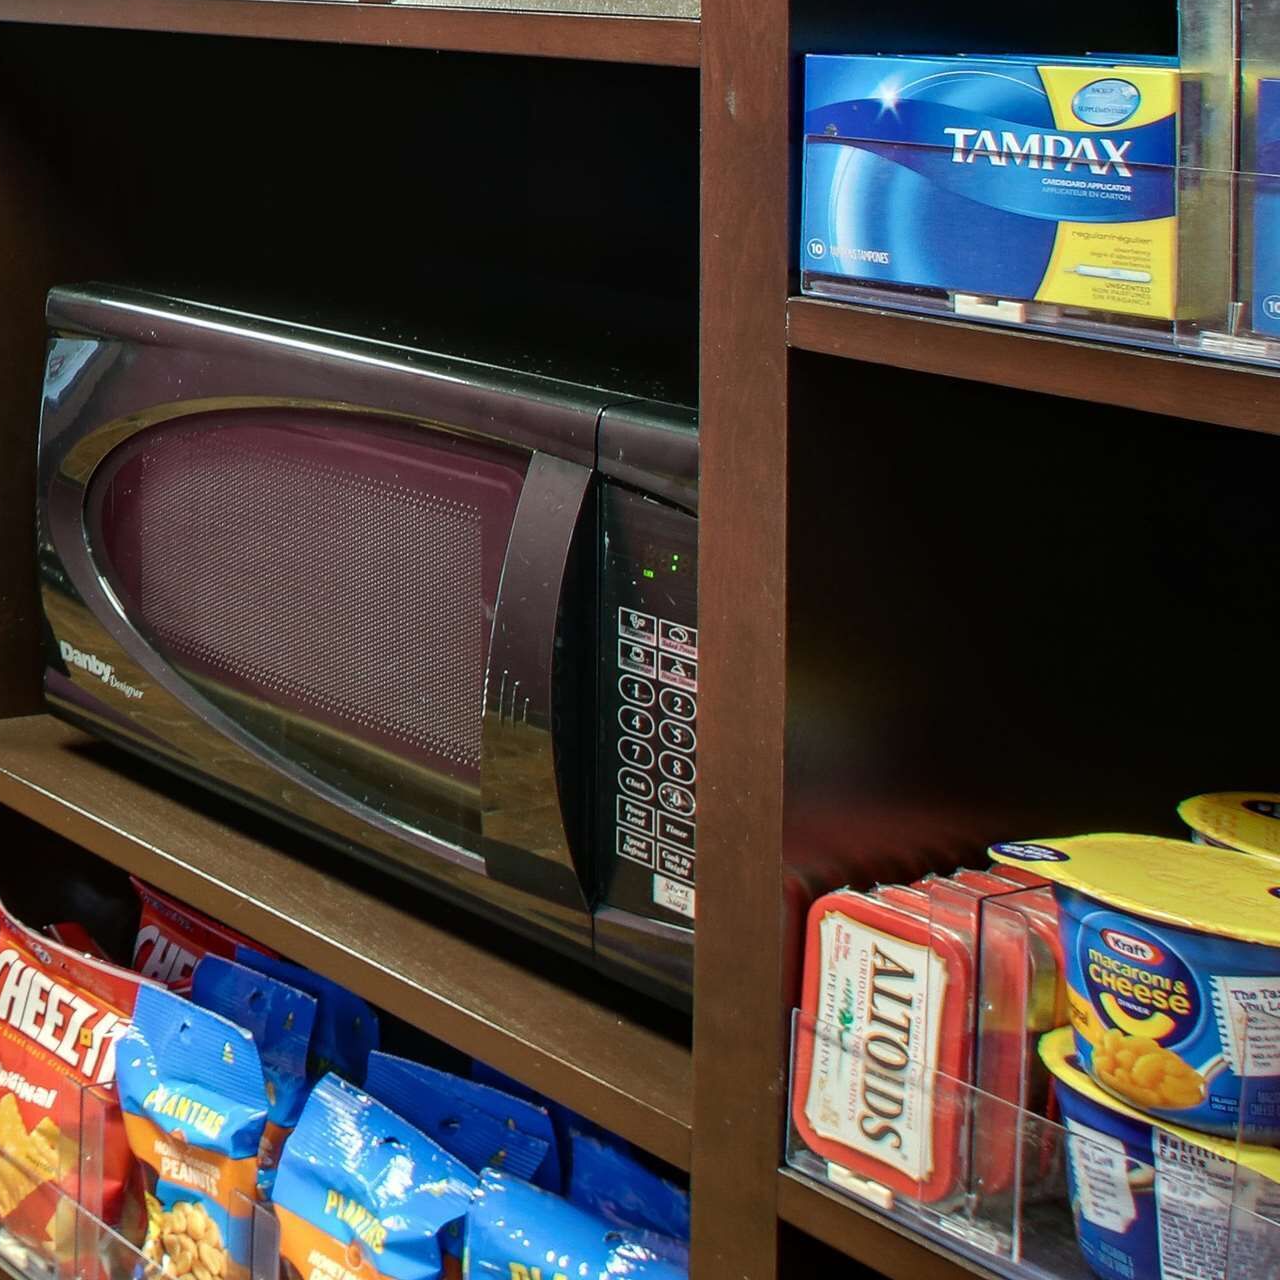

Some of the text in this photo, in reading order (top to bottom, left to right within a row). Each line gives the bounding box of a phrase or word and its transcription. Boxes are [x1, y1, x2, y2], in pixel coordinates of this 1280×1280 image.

[943, 127, 1133, 178] TAMPAX
[1042, 177, 1132, 193] CARDBOARD APPLICATOR
[810, 242, 823, 255] 10
[1104, 282, 1152, 294] UNSCENTED
[59, 639, 112, 683] Danby
[633, 683, 639, 698] 1
[673, 696, 682, 712] 2
[632, 715, 640, 729] 4
[673, 728, 682, 743] 5
[632, 745, 640, 759] 7
[672, 759, 682, 775] 8
[665, 823, 688, 839] Timer
[661, 849, 680, 863] Cook
[1110, 935, 1150, 960] Kraft
[1088, 948, 1187, 997] macaroni &
[858, 941, 915, 1150] ALTOIDS
[1159, 1146, 1207, 1169] Facts
